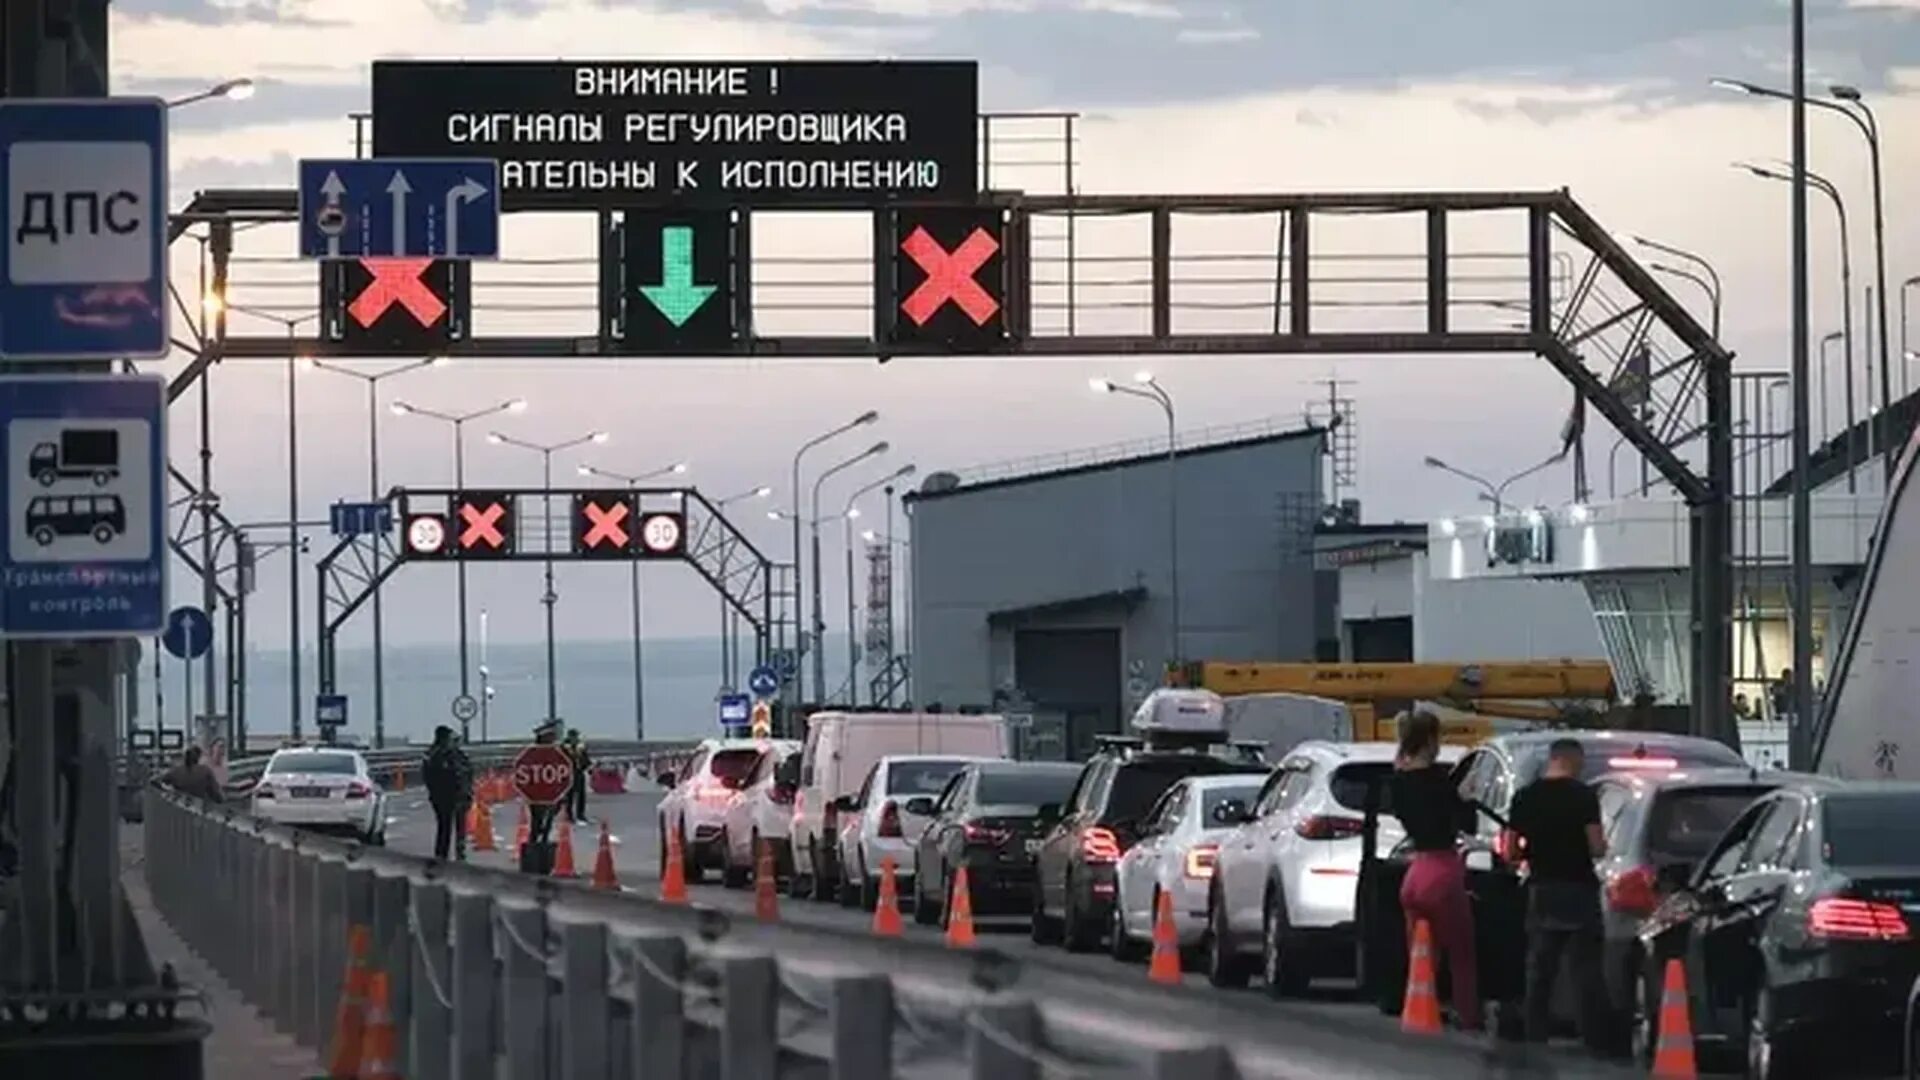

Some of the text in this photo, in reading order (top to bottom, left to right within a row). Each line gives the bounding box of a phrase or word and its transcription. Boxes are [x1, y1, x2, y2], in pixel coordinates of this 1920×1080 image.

[575, 67, 778, 95] ВНИМАНИЕ !
[448, 113, 906, 145] СИГНАЛЫ РЕГУЛИРОВЩИКА
[502, 160, 938, 188] АТЕЛЬНЫ К ИСПОЛНЕНИЮ
[17, 190, 140, 244] ДПС
[653, 523, 673, 543] 30
[29, 596, 131, 616] контроль
[515, 764, 568, 784] STOP
